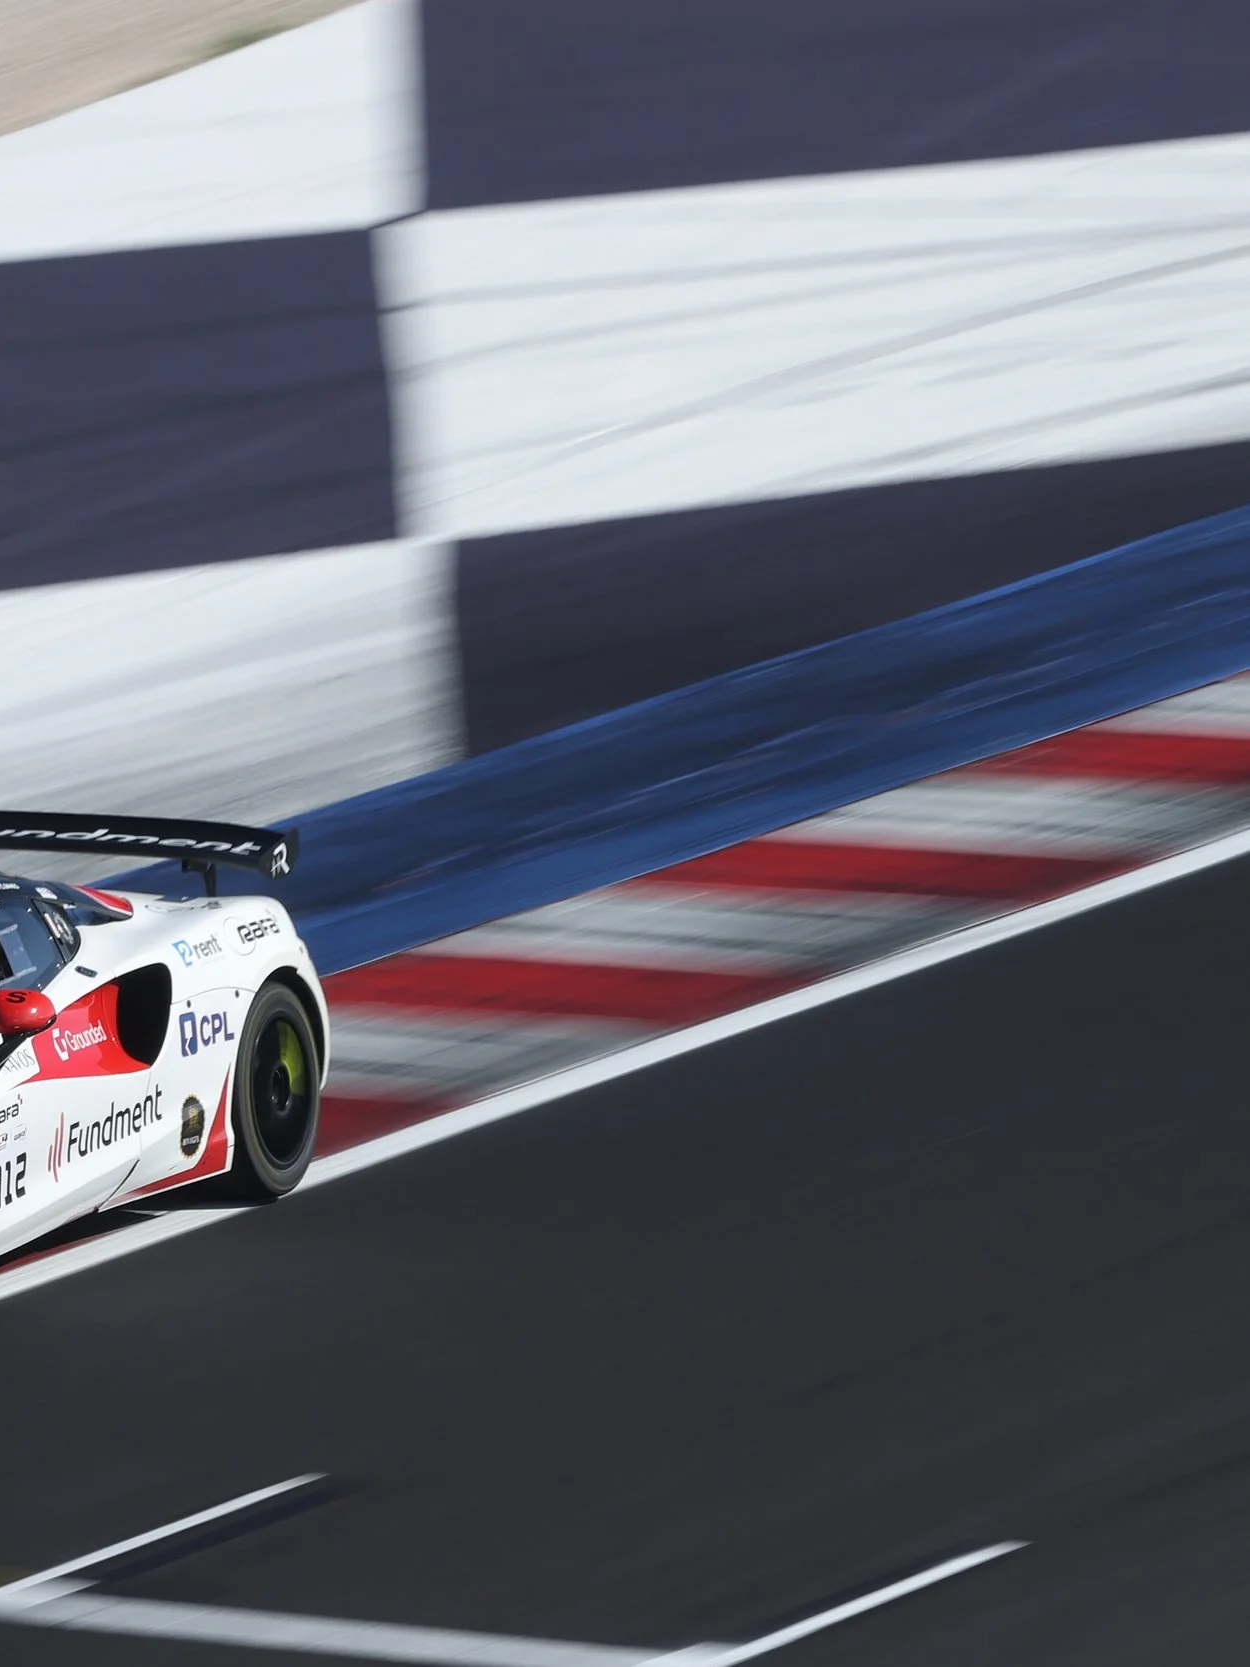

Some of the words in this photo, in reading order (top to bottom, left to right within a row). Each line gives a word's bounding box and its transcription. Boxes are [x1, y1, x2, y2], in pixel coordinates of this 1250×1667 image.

[5, 991, 27, 1004] S
[64, 1019, 108, 1053] Grounded
[200, 1011, 235, 1047] CPL
[67, 1083, 163, 1163] Fundment
